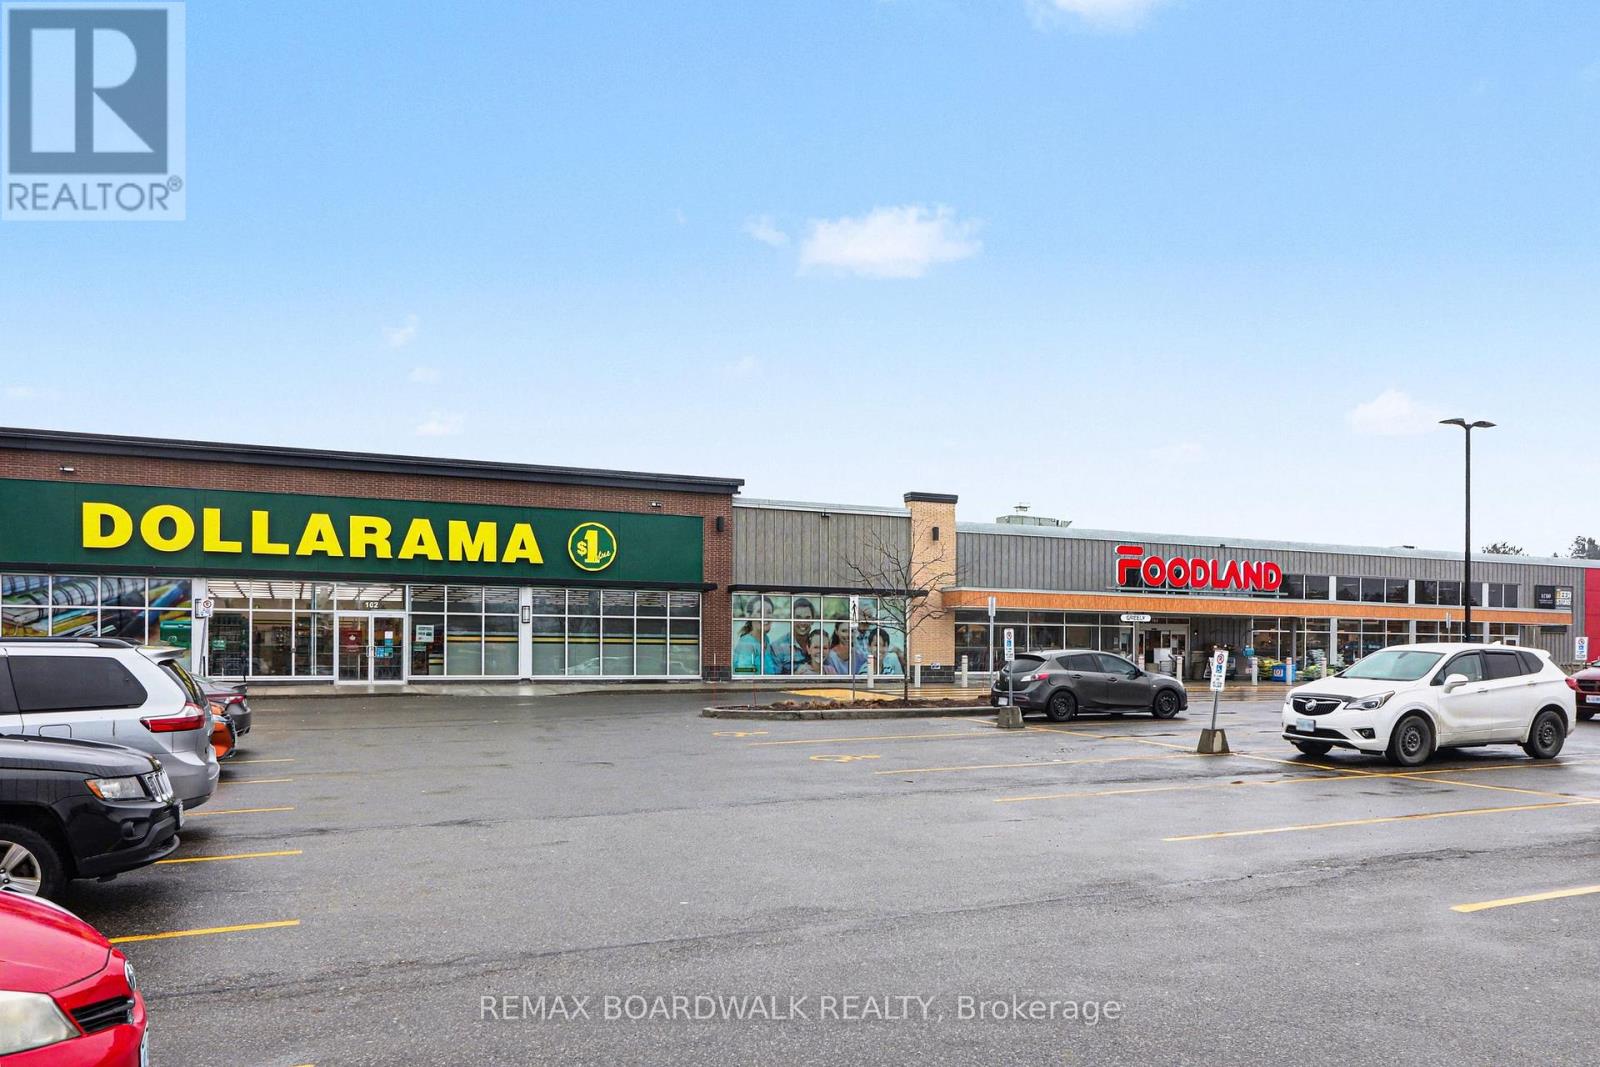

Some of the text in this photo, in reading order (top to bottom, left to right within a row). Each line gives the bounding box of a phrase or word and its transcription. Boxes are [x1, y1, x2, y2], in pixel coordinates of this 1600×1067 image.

[82, 502, 544, 564] DOLLARAMA
[1115, 545, 1283, 591] FOODLAND
[364, 601, 379, 609] 102
